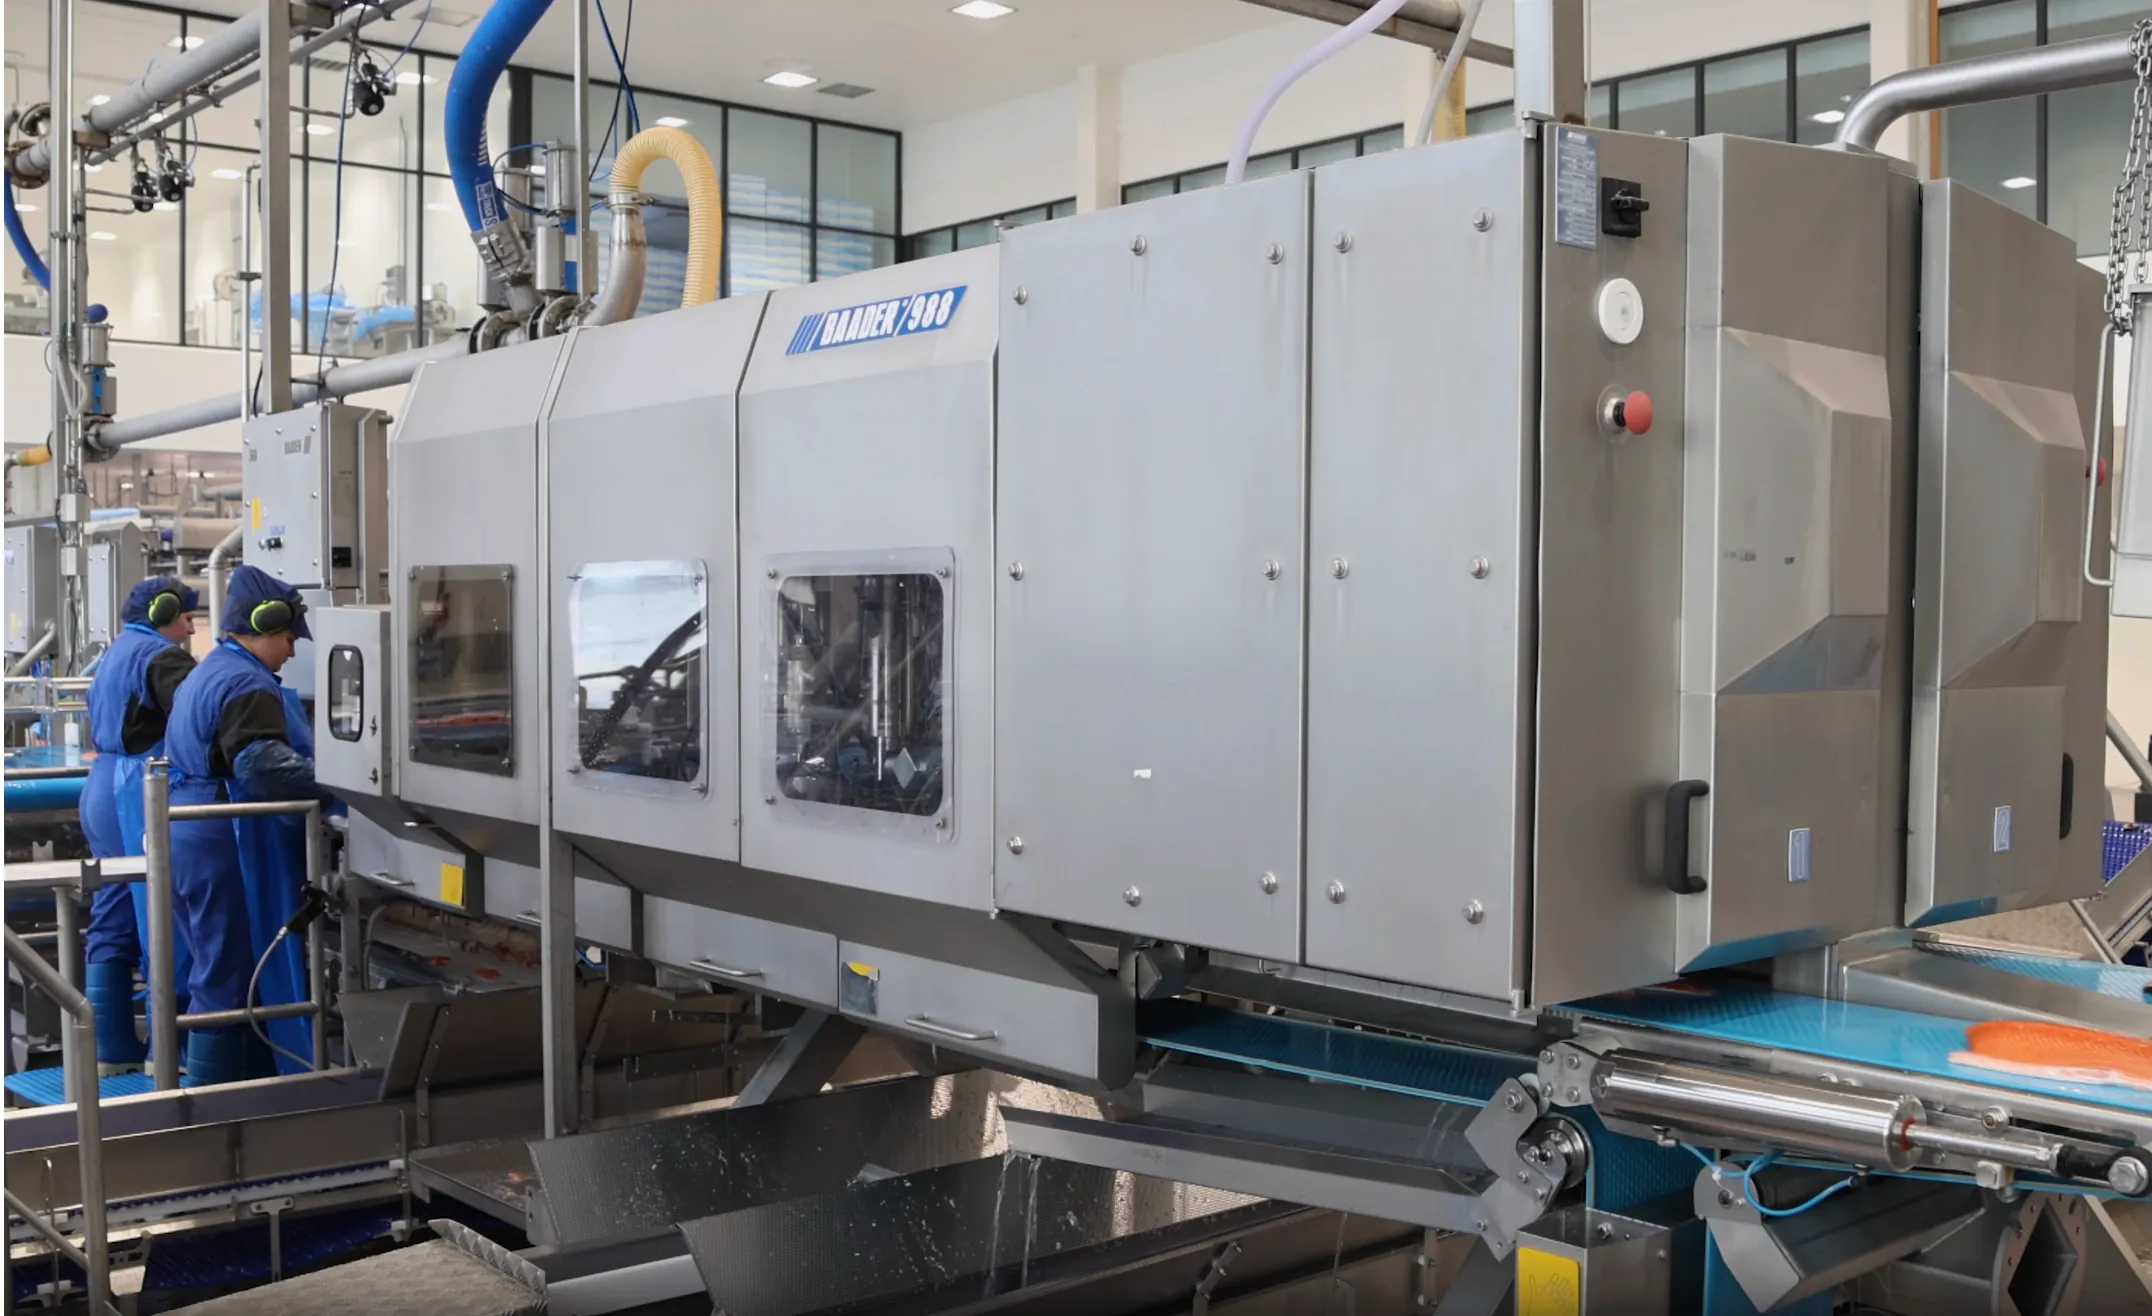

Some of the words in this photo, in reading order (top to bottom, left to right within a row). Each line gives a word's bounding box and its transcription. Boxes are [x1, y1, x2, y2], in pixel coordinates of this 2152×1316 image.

[819, 299, 900, 346] BAADER
[907, 290, 955, 331] 988
[1997, 808, 2010, 850] 2
[1794, 831, 1805, 878] 1
